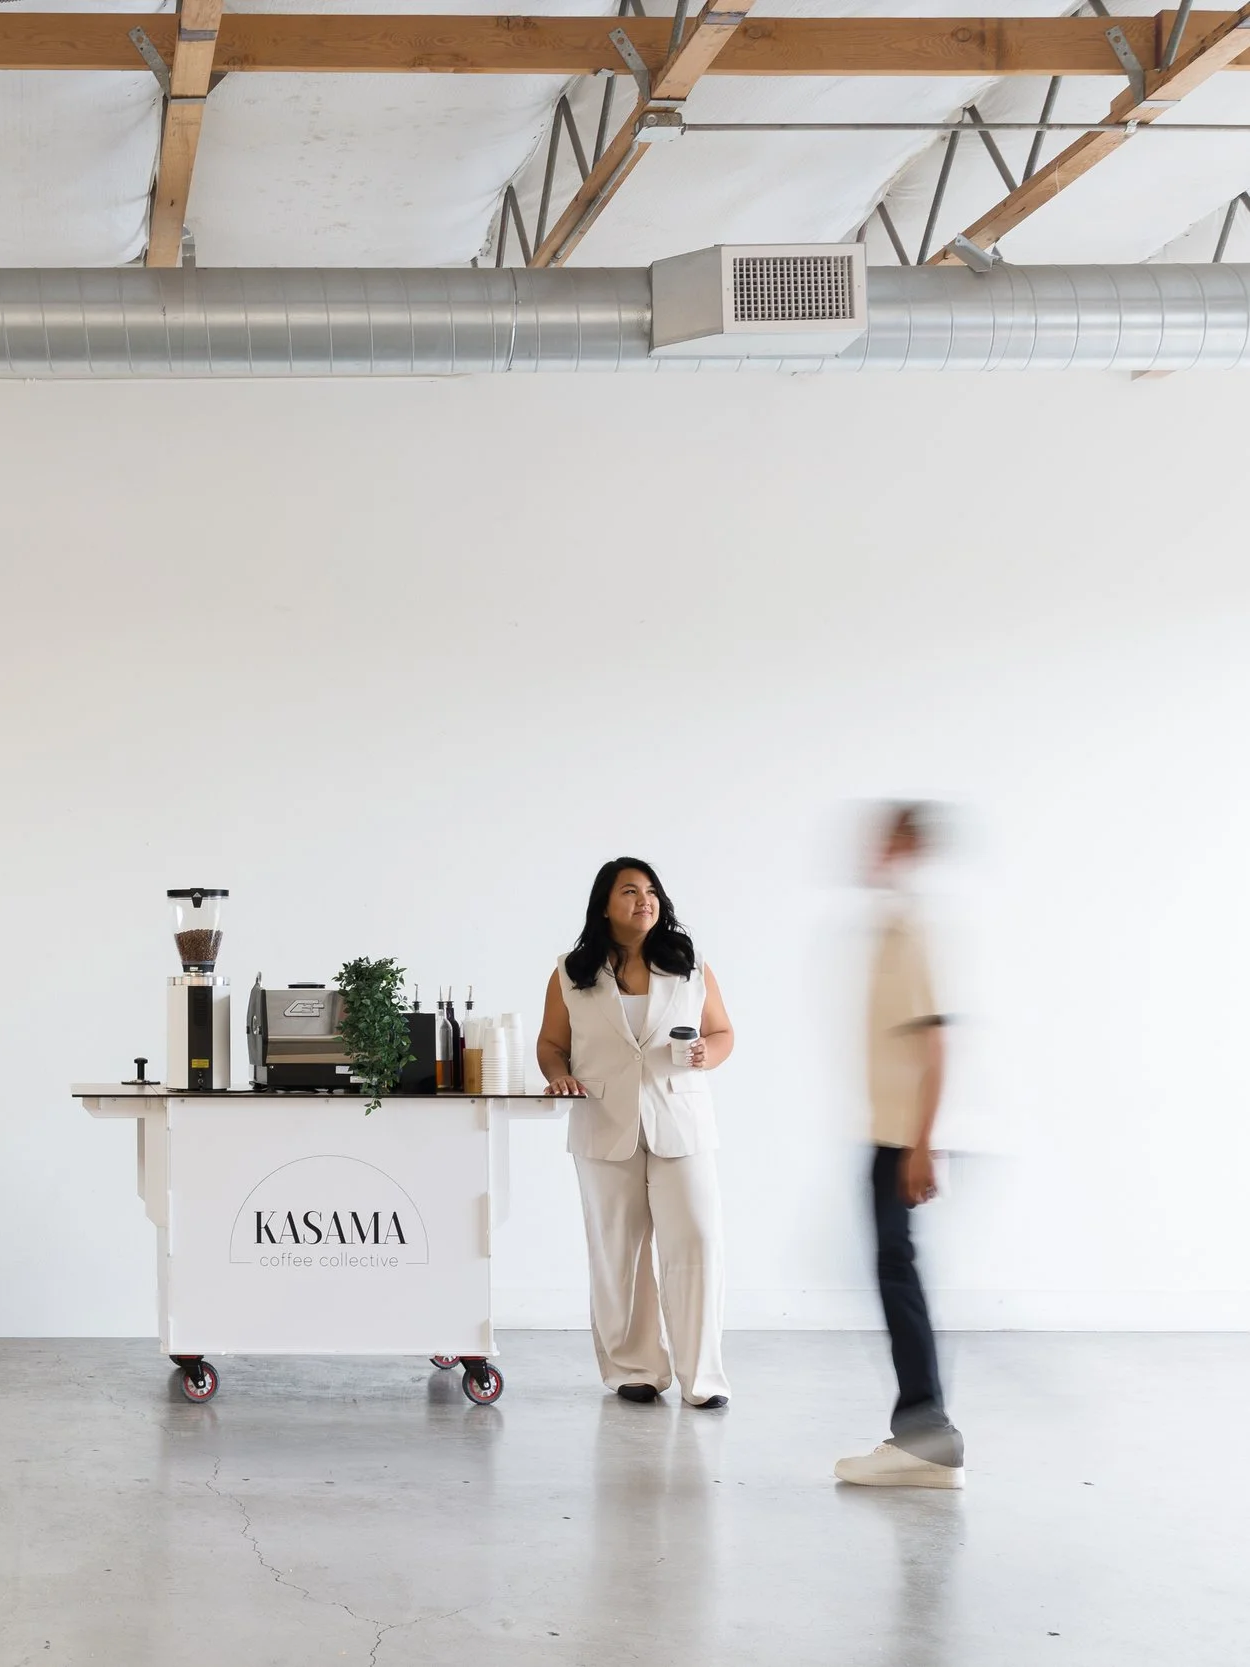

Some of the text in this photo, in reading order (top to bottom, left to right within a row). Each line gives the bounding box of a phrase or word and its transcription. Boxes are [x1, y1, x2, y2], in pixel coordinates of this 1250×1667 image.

[254, 1210, 408, 1244] KASAMA
[259, 1252, 398, 1268] coffee collective
